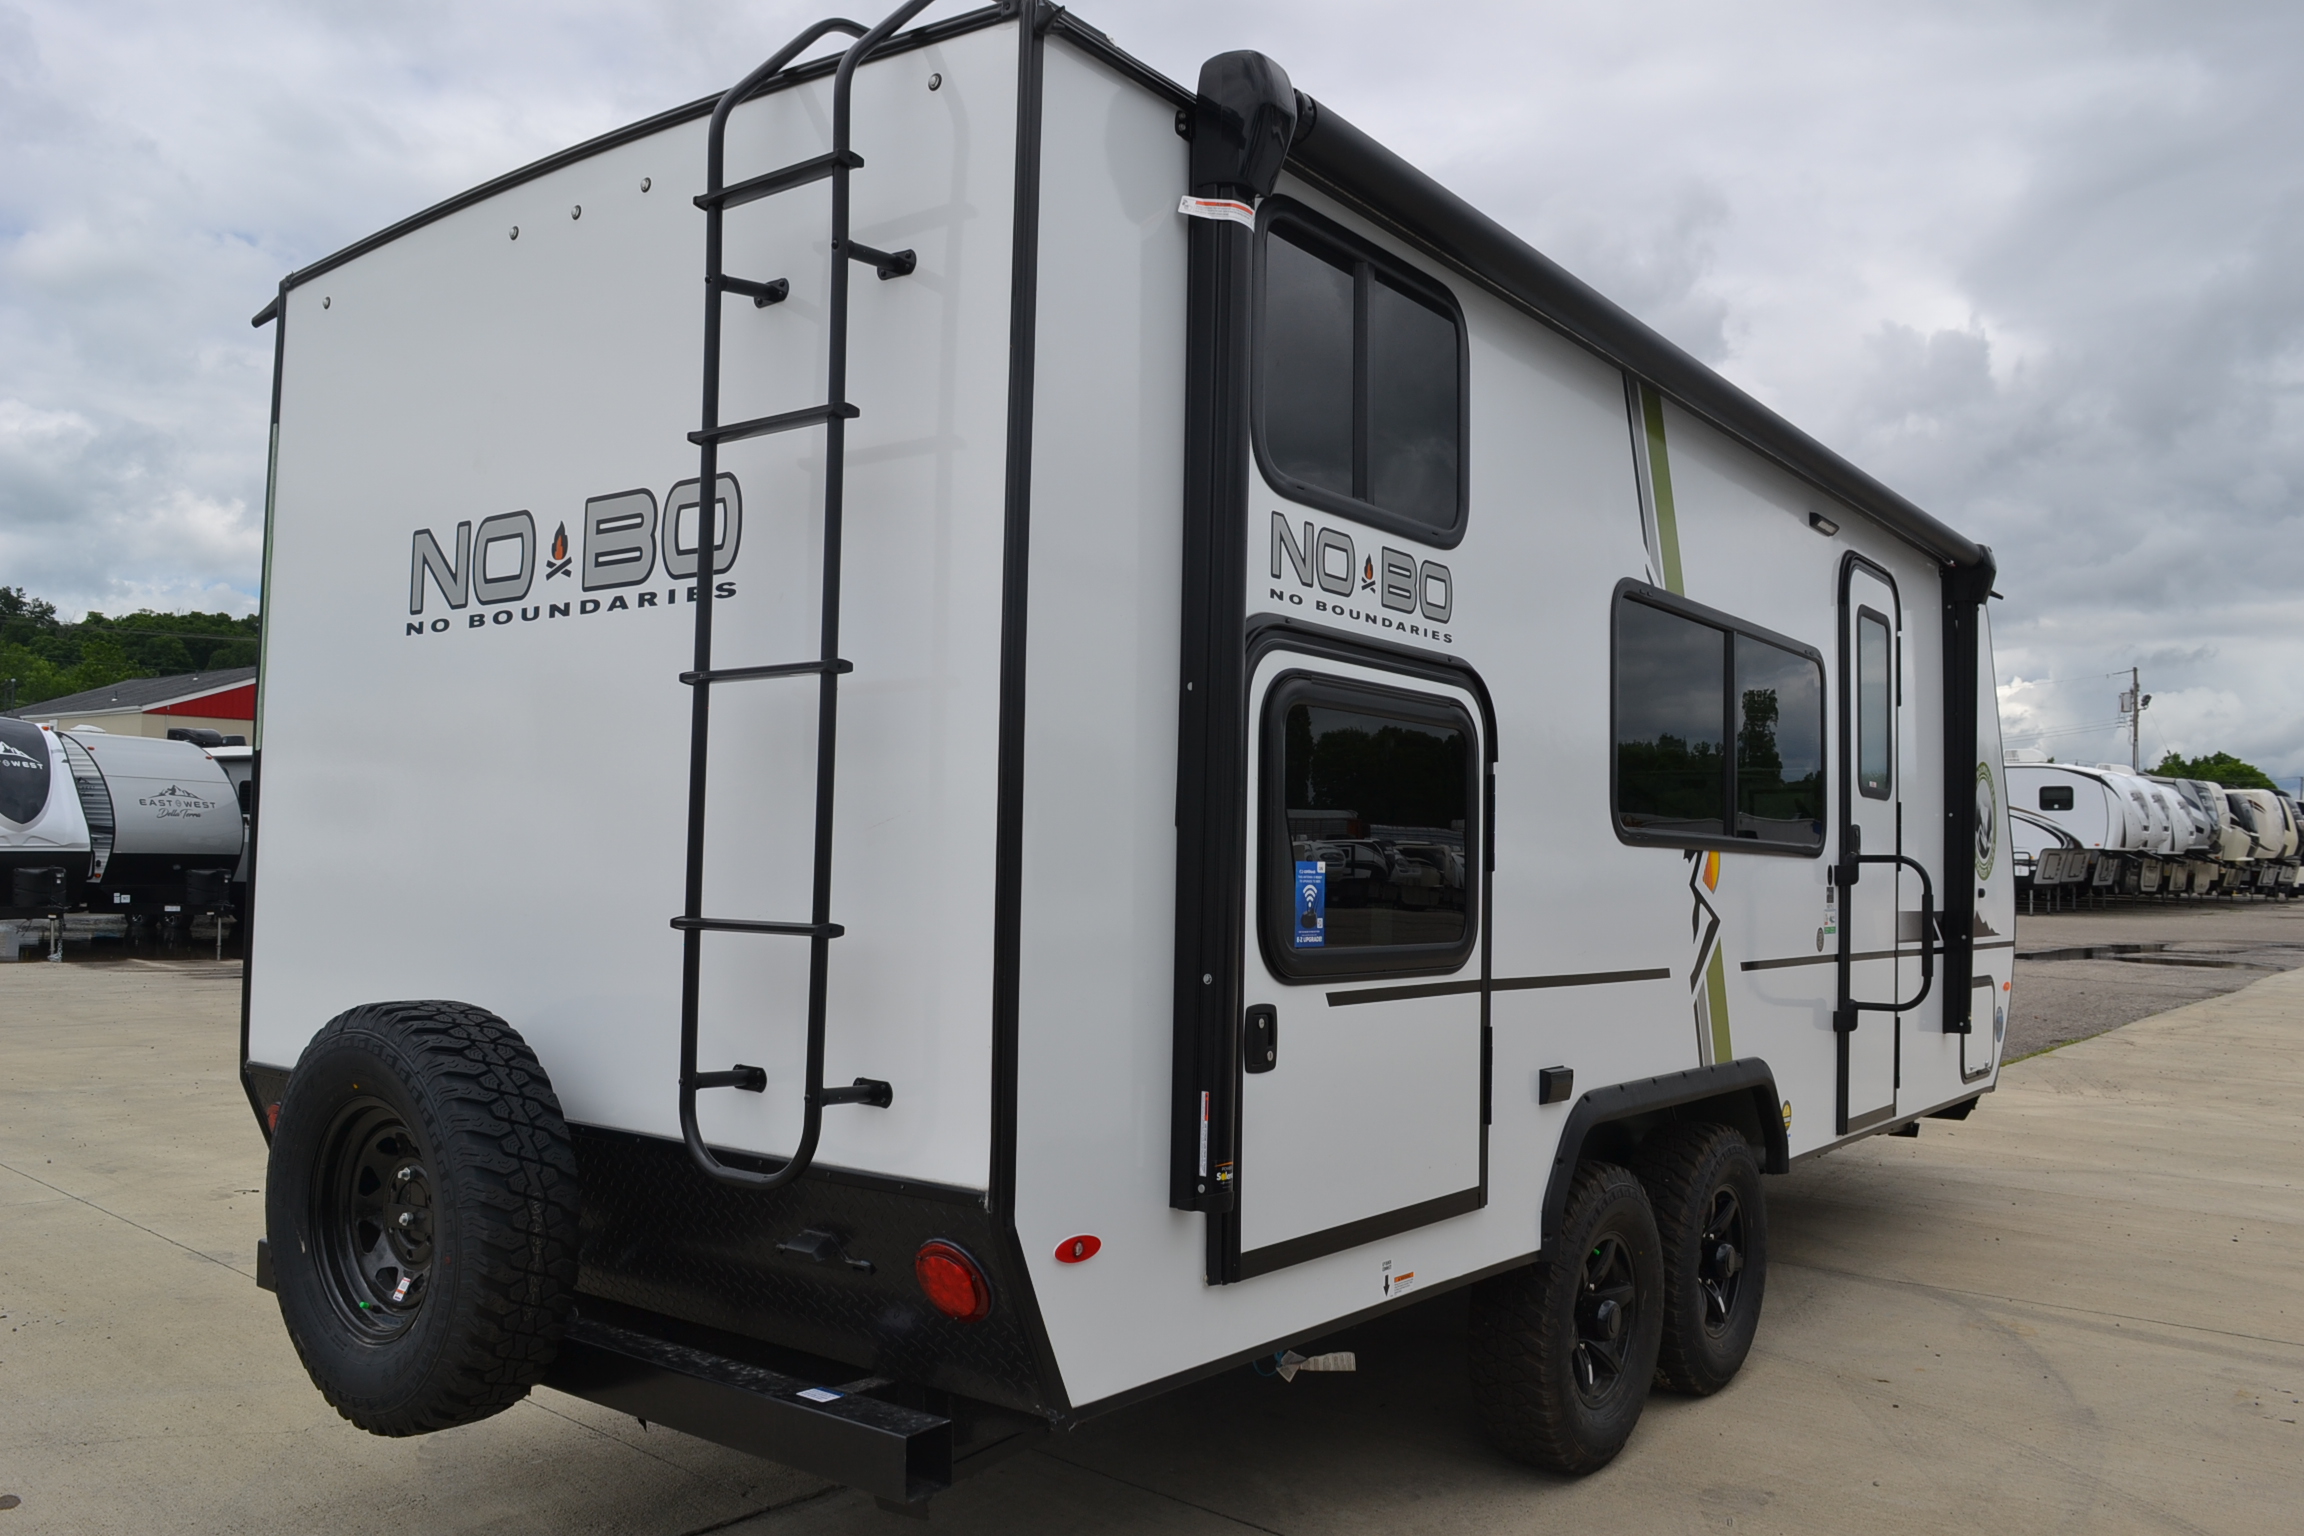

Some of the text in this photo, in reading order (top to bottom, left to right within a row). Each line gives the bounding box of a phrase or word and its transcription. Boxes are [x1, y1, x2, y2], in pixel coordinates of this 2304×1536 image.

[409, 471, 743, 615] NO BO
[1271, 511, 1452, 624] NO BO
[405, 617, 450, 636] NO
[1269, 588, 1453, 644] NO BOUNDARIES
[10, 760, 44, 770] WEST
[139, 798, 172, 806] EAST
